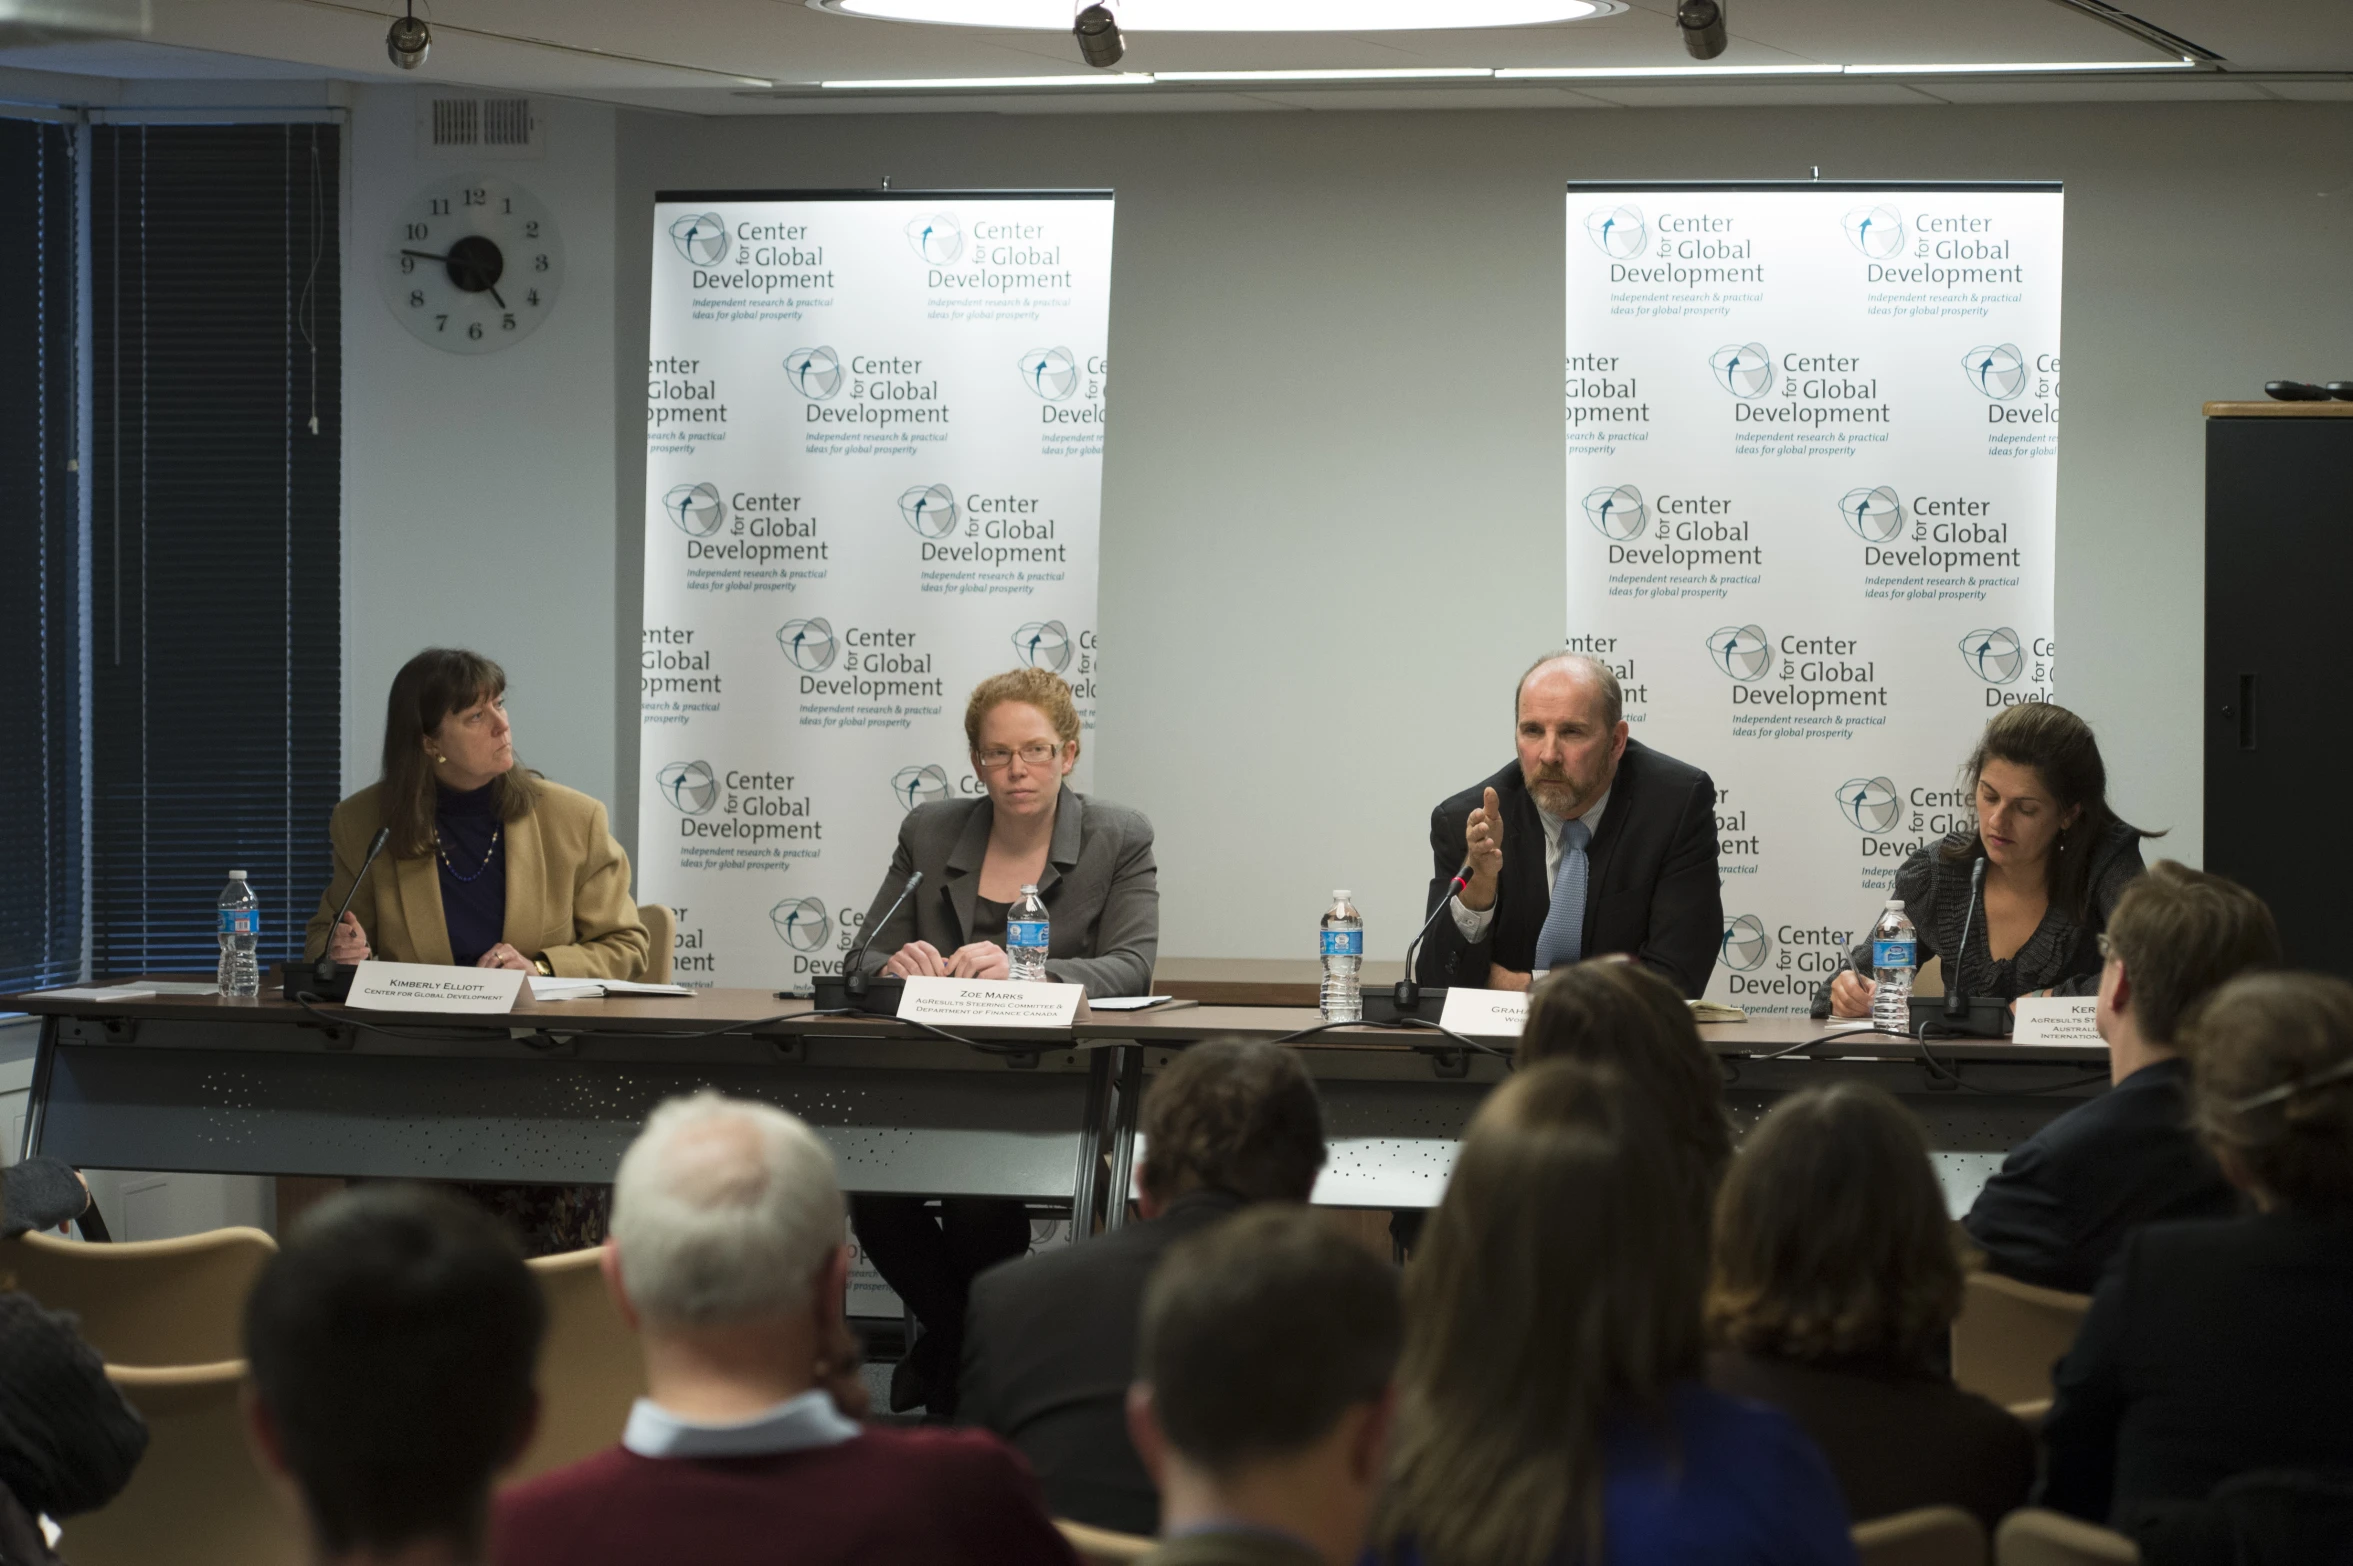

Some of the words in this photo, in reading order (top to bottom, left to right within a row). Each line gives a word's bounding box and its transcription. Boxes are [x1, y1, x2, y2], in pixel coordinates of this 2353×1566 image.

[464, 188, 486, 206] 12
[503, 198, 512, 214] 1
[431, 200, 450, 215] 11
[406, 222, 428, 240] 10
[526, 221, 539, 238] 2
[737, 222, 807, 241] Center
[974, 222, 1044, 239] Center
[1659, 214, 1733, 232] Center
[1916, 214, 1992, 232] Center
[735, 244, 749, 266] for
[755, 247, 822, 266] Global
[972, 244, 986, 264] for
[992, 246, 1059, 265] Global
[1657, 237, 1671, 258] for
[1678, 240, 1750, 259] Global
[1914, 237, 1929, 259] for
[1936, 240, 2008, 259] Global
[401, 256, 414, 274] 9
[536, 254, 548, 272] 3
[692, 269, 835, 294] Development
[929, 269, 1071, 294] Development
[1611, 263, 1763, 288] Development
[1868, 263, 2022, 289] Development
[410, 290, 424, 307] 8
[528, 289, 540, 306] 4
[435, 314, 448, 332] 7
[469, 322, 482, 340] 6
[502, 314, 516, 330] 5
[852, 356, 921, 374] Center
[1784, 353, 1859, 372] Center
[850, 378, 864, 399] for
[870, 381, 937, 400] Global
[1085, 378, 1098, 400] for
[1782, 376, 1797, 398] for
[1804, 379, 1876, 399] Global
[2035, 377, 2049, 400] for
[806, 403, 948, 428] Development
[1736, 402, 1890, 428] Development
[1608, 432, 1648, 442] practical
[1735, 432, 1794, 443] Independent
[1797, 433, 1835, 441] research
[1838, 433, 1845, 441] &
[1848, 433, 1889, 443] practical
[1569, 446, 1616, 455] prosperity
[1736, 445, 1759, 454] ideas
[1760, 445, 1775, 456] for
[1777, 445, 1806, 456] global
[1809, 446, 1856, 456] prosperity
[1988, 447, 2012, 456] ideas
[2014, 447, 2028, 458] for
[732, 493, 800, 512] Center
[967, 494, 1038, 513] Center
[1657, 495, 1731, 514] Center
[1914, 497, 1990, 516] Center
[730, 515, 744, 536] for
[750, 517, 815, 537] Global
[965, 516, 979, 538] for
[985, 519, 1054, 539] Global
[1655, 518, 1670, 540] for
[1676, 521, 1748, 541] Global
[1912, 520, 1927, 542] for
[1933, 523, 2006, 543] Global
[688, 539, 828, 566] Development
[922, 542, 1066, 567] Development
[1610, 544, 1762, 570] Development
[1866, 546, 2020, 572] Development
[1609, 574, 1667, 585] Independent
[1670, 574, 1707, 583] research
[1710, 574, 1717, 583] &
[1720, 575, 1761, 586] practical
[1865, 576, 1924, 587] Independent
[1927, 577, 1965, 585] research
[1968, 577, 1976, 585] &
[1978, 577, 2019, 588] practical
[1609, 587, 1632, 596] ideas
[1634, 587, 1648, 598] for
[1651, 587, 1679, 599] global
[1681, 588, 1728, 599] prosperity
[1865, 589, 1889, 598] ideas
[1890, 589, 1905, 600] for
[1907, 589, 1936, 600] global
[1938, 591, 1986, 601] prosperity
[846, 628, 916, 647] Center
[1781, 636, 1857, 655] Center
[844, 650, 858, 672] for
[864, 653, 930, 673] Global
[1078, 652, 1090, 674] for
[1779, 658, 1794, 681] for
[1801, 661, 1873, 682] Global
[2032, 661, 2044, 683] for
[800, 675, 942, 701] Development
[1733, 684, 1887, 711] Development
[799, 703, 854, 715] Independent
[857, 705, 893, 714] research
[895, 705, 902, 714] &
[904, 706, 942, 717] practical
[799, 716, 822, 725] ideas
[822, 716, 837, 728] for
[838, 717, 866, 728] global
[868, 718, 911, 729] prosperity
[1733, 714, 1791, 726] Independent
[1794, 715, 1832, 724] research
[1835, 716, 1843, 724] &
[1846, 716, 1886, 727] practical
[1733, 727, 1756, 736] ideas
[1757, 727, 1772, 739] for
[1775, 728, 1804, 739] global
[1806, 729, 1853, 740] prosperity
[726, 771, 794, 790] Center
[724, 793, 738, 814] for
[743, 796, 809, 816] Global
[682, 818, 821, 844] Development
[1908, 810, 1924, 833] for
[1776, 948, 1792, 971] for
[2072, 1006, 2096, 1014] KER
